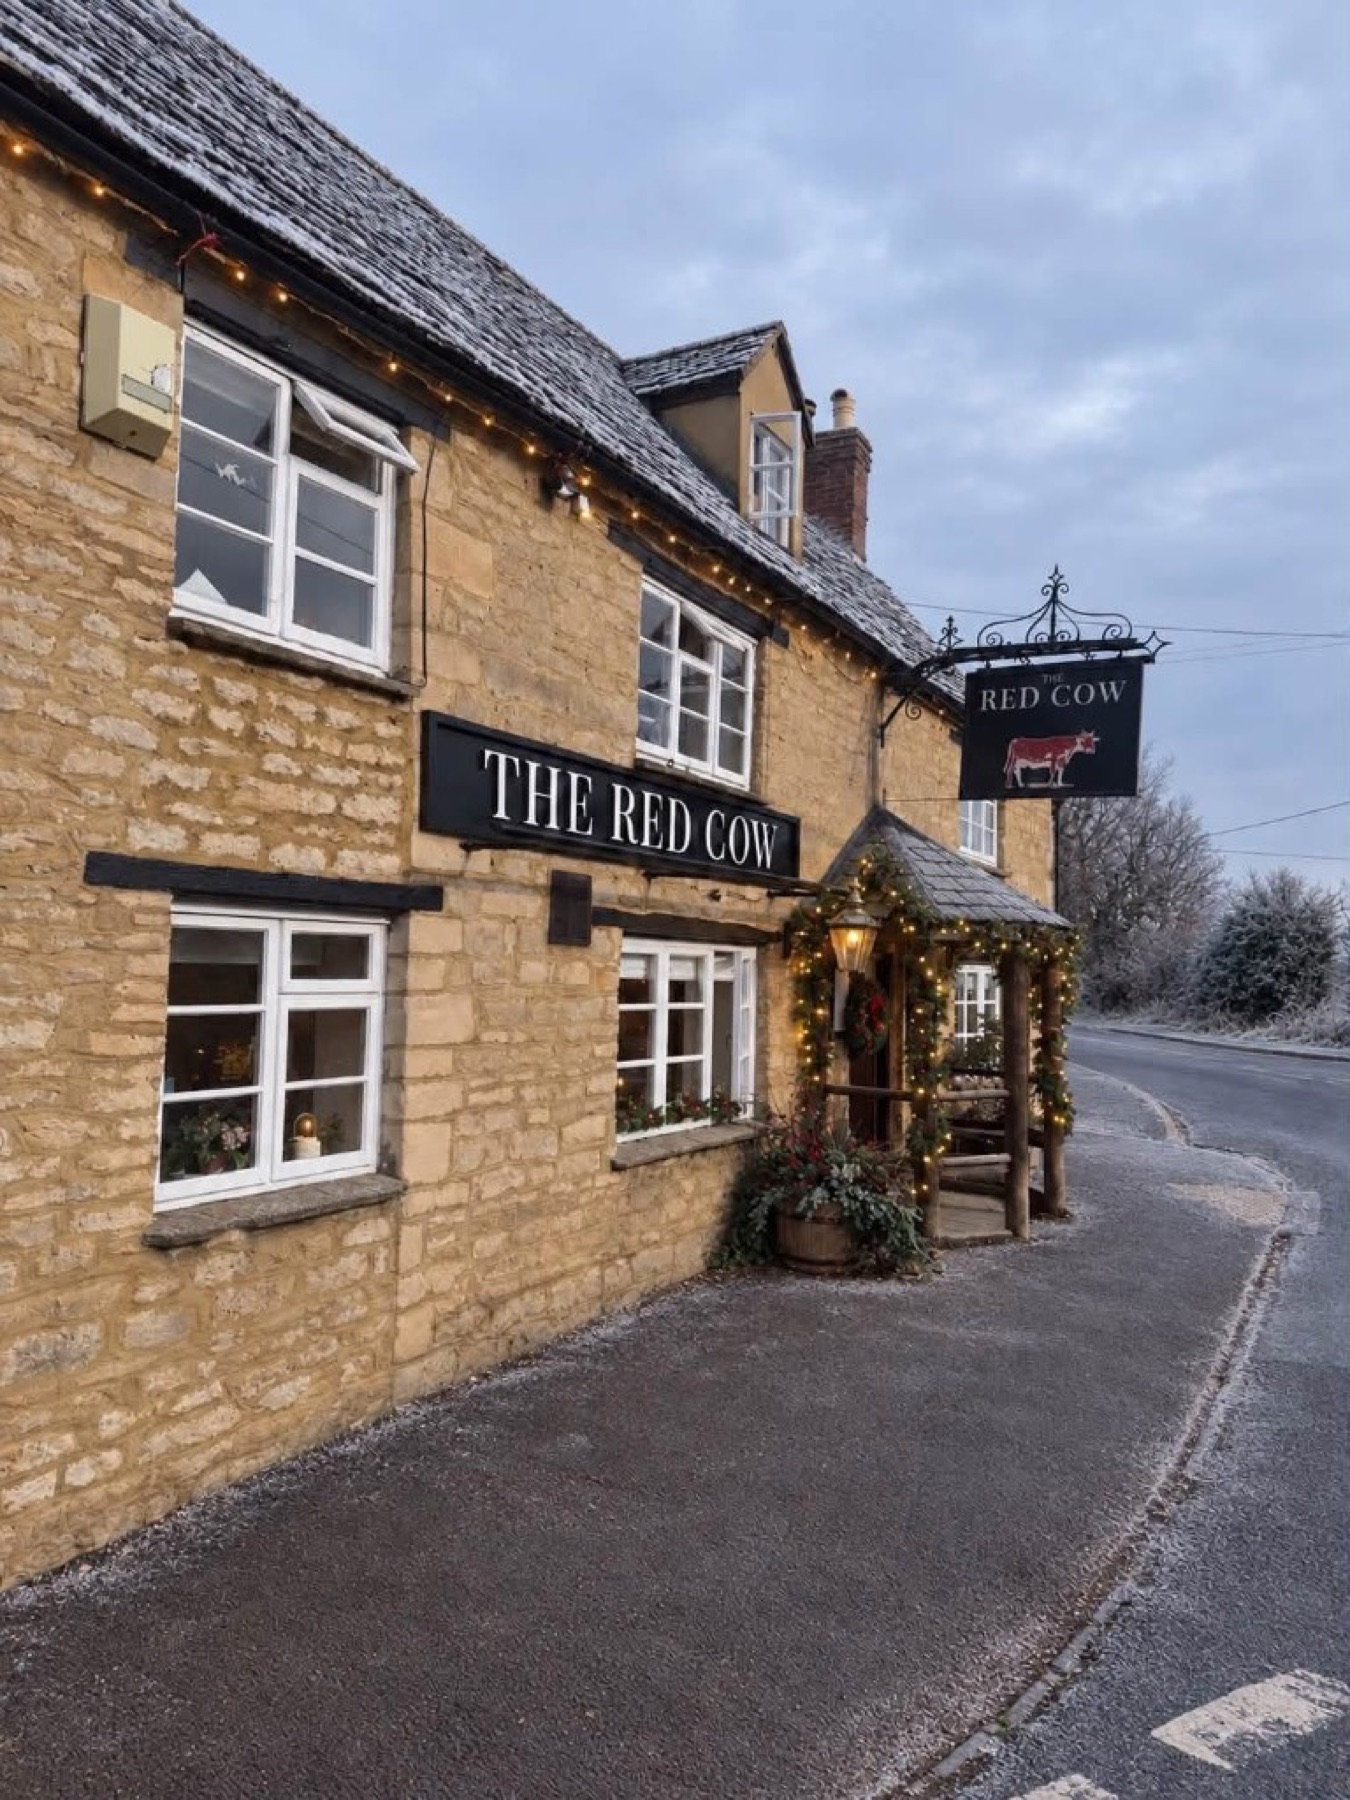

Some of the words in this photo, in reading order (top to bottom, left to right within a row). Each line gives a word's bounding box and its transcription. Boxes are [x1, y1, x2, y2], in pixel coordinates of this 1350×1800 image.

[1042, 673, 1064, 684] THE
[980, 686, 1040, 711] RED
[1051, 680, 1127, 707] COW
[483, 748, 593, 836] THE
[611, 782, 692, 854] RED
[705, 808, 780, 869] COW
